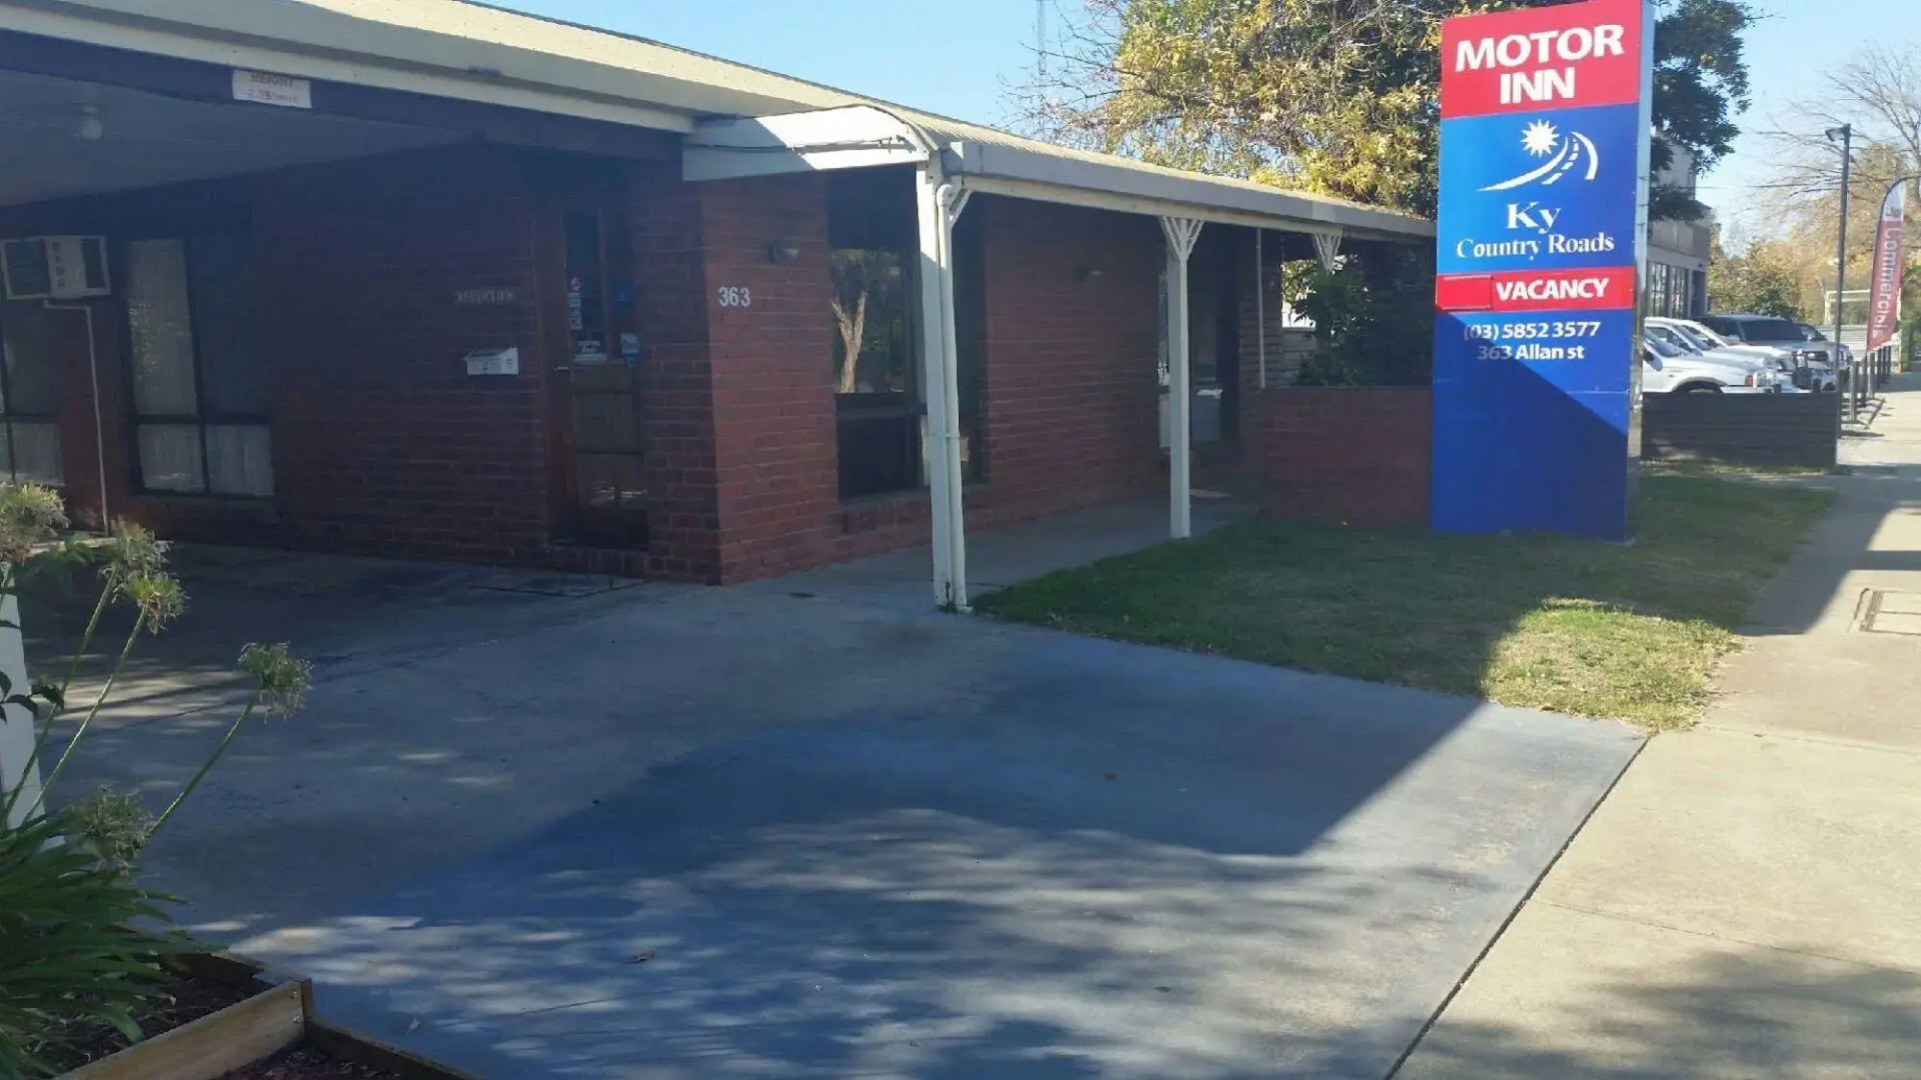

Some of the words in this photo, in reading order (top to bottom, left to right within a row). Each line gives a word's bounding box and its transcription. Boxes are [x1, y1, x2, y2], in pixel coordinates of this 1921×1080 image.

[1455, 24, 1625, 72] MOTOR
[1500, 67, 1575, 104] INN
[1507, 201, 1562, 234] Ky
[1456, 238, 1541, 260] Country
[1548, 232, 1615, 253] Roads
[719, 286, 750, 307] 363
[1495, 278, 1609, 301] VACANCY
[1464, 323, 1499, 340] (03)
[1501, 323, 1549, 339] 5852
[1552, 321, 1601, 338] 3577
[1477, 346, 1511, 360] 363
[1514, 344, 1564, 360] Allan
[1567, 345, 1585, 360] st
